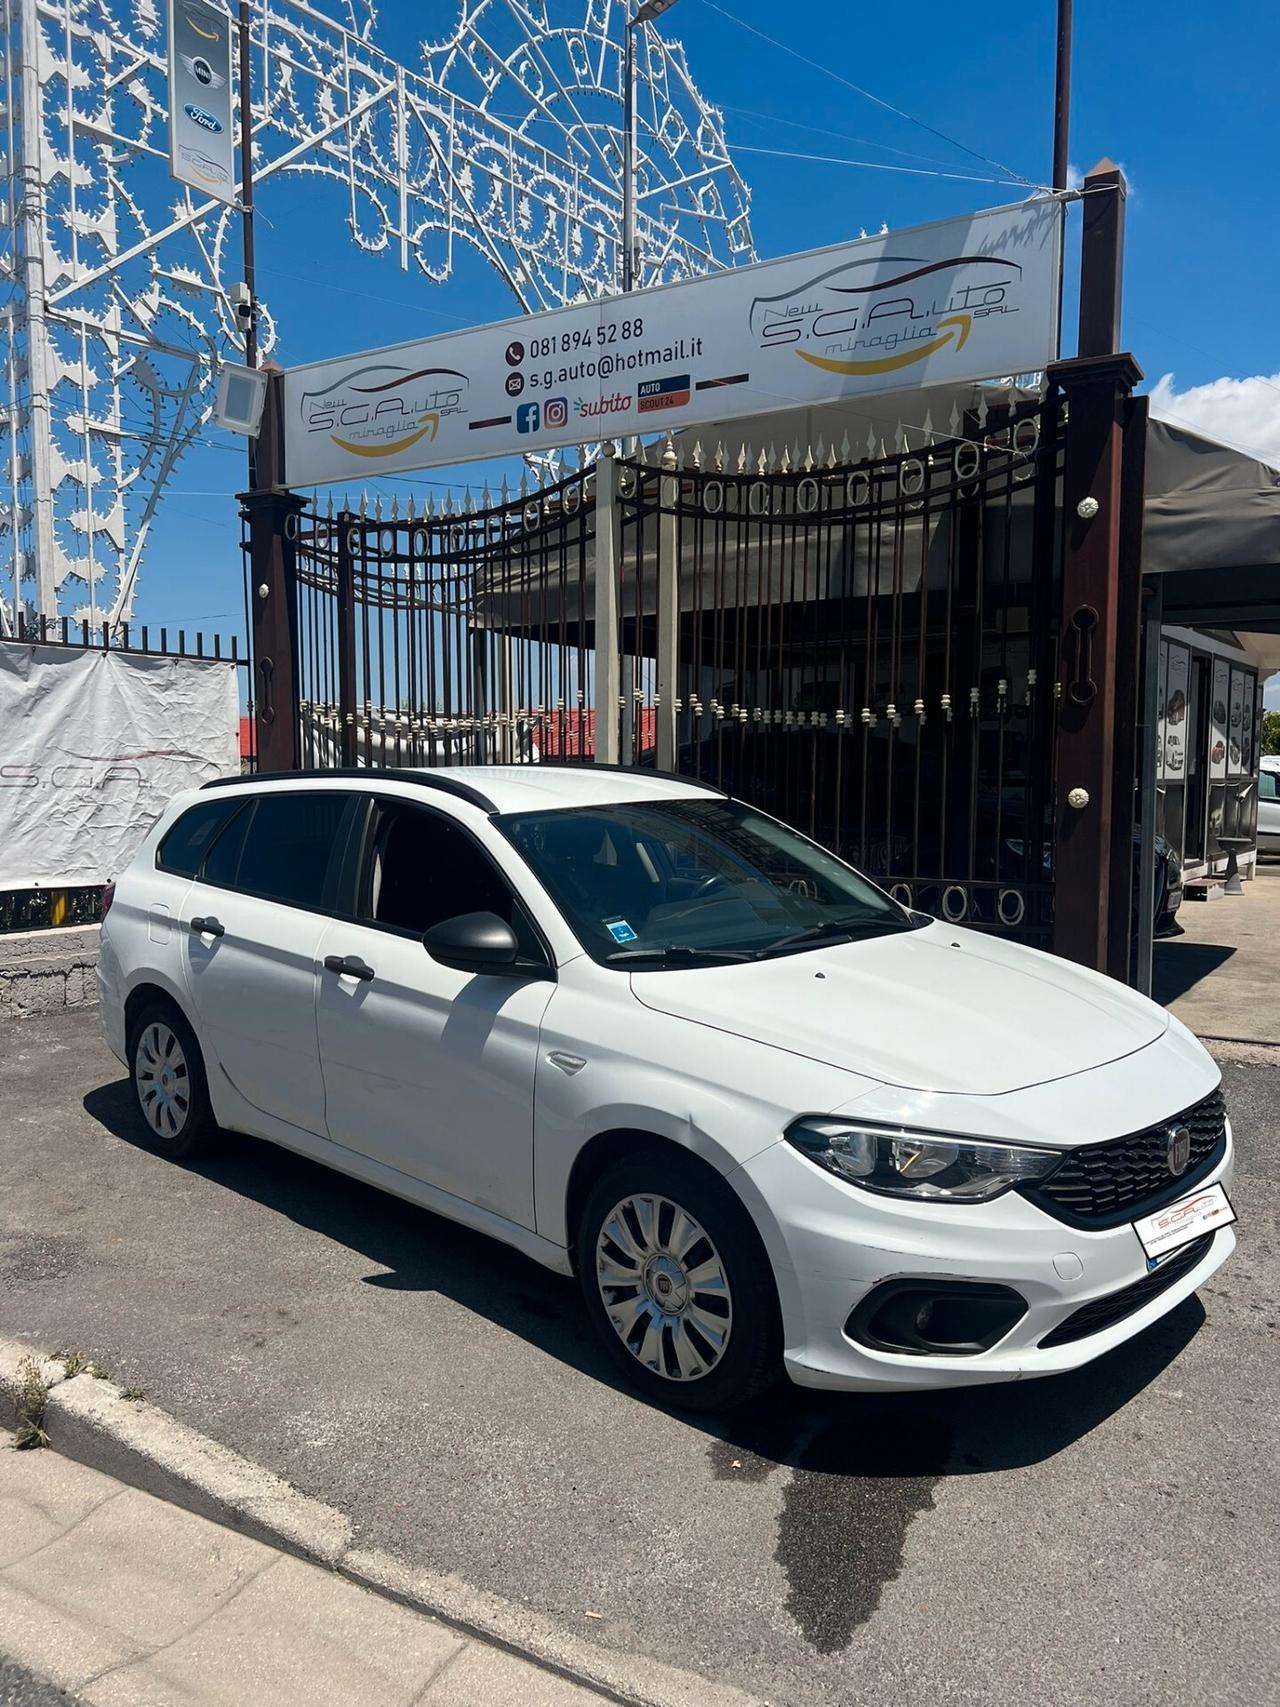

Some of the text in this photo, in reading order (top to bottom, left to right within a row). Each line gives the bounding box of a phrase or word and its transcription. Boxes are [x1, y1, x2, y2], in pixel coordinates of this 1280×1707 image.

[191, 108, 217, 130] Ford
[764, 303, 823, 322] New
[973, 305, 1020, 319] SRL
[530, 318, 643, 359] 081 894 52 88
[825, 324, 938, 355] miraglia
[530, 338, 702, 389] s.g.auto@hotmail.it
[640, 382, 661, 395] AUTO
[309, 399, 347, 411] New
[580, 392, 633, 418] subito
[350, 421, 419, 439] miraglia
